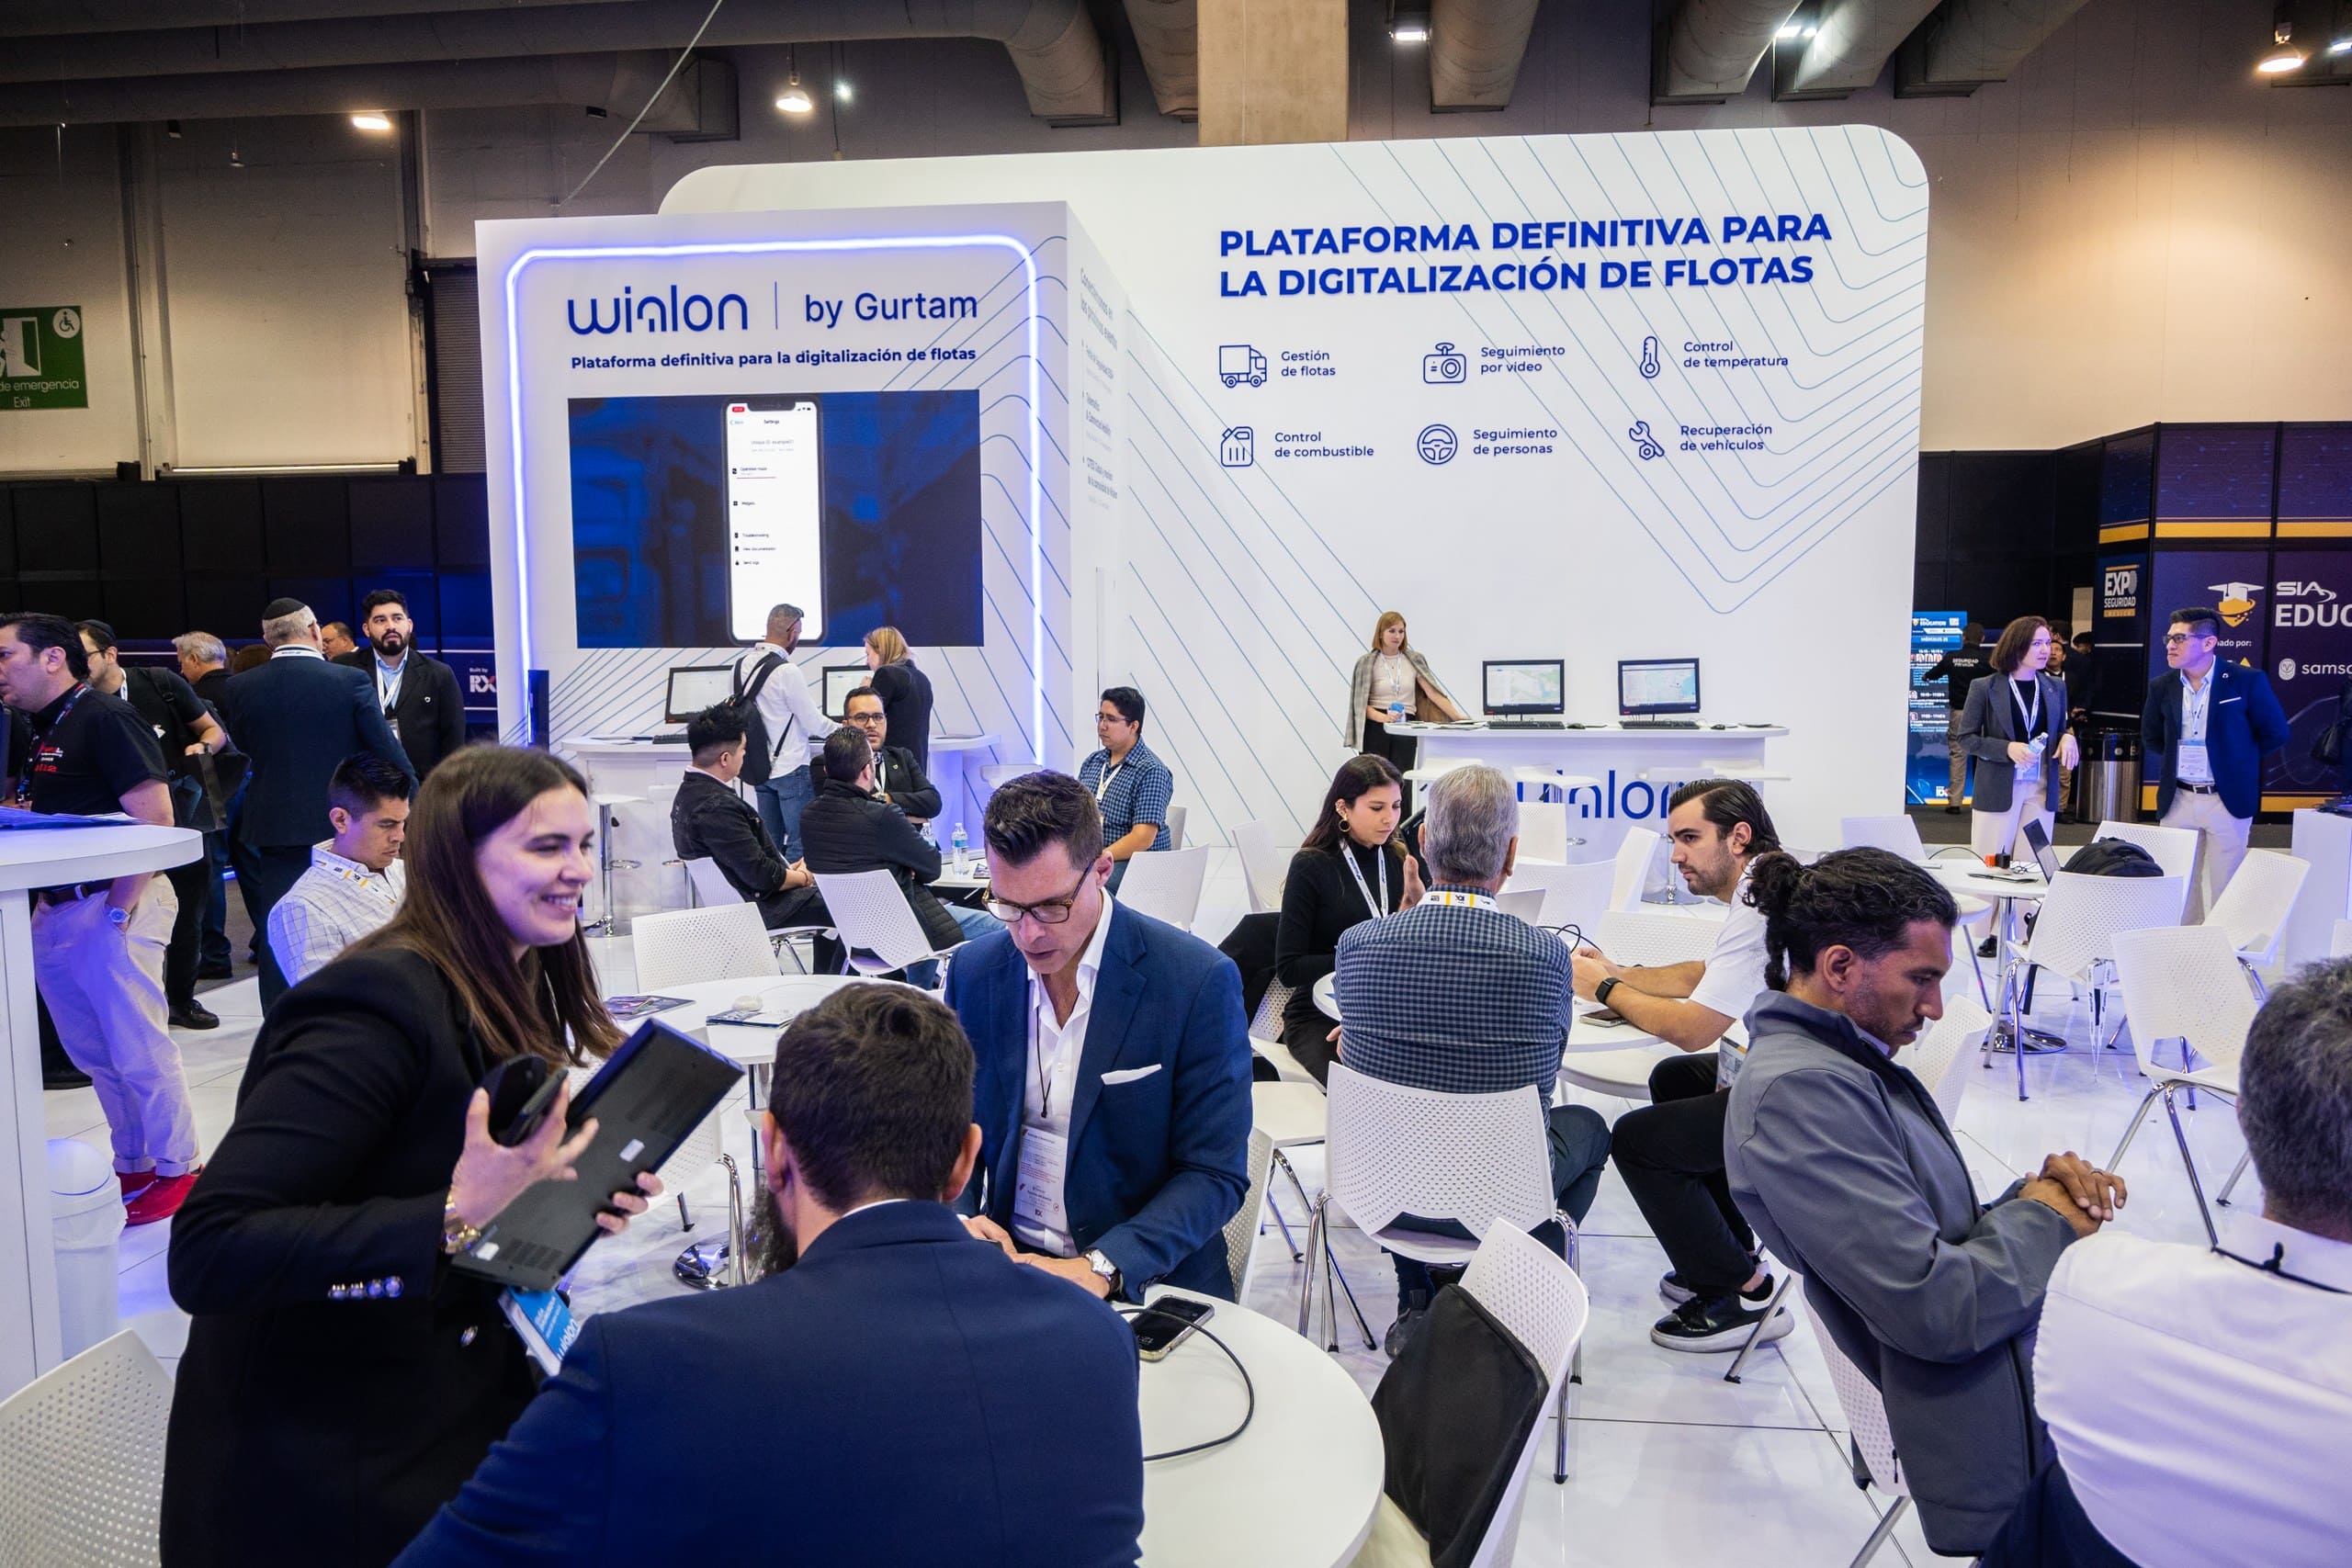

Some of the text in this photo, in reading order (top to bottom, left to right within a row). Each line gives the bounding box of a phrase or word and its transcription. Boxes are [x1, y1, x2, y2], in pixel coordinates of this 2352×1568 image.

[1220, 213, 1833, 257] PLATAFORMA DEFINITIVA PARA
[1220, 255, 1815, 297] LA DIGITALIZACIÓN DE FLOTAS
[567, 284, 748, 335] wialon
[805, 292, 978, 329] by Gurtam
[1480, 345, 1566, 359] Seguimiento
[1683, 341, 1734, 352] Control
[571, 348, 977, 368] Plataforma definitiva para la digitalización de flotas
[1281, 350, 1330, 361] Gestión
[1683, 356, 1789, 369] de temperatura
[1281, 366, 1336, 377] de flotas
[1480, 361, 1543, 375] por video
[14, 378, 80, 393] emergencia
[14, 396, 30, 408] Exit
[1274, 431, 1321, 442] Control
[1473, 427, 1558, 441] Seguimiento
[1679, 423, 1772, 437] Recuperación
[1274, 446, 1374, 457] de combustible
[1473, 445, 1553, 457] de personas
[1679, 439, 1764, 450] de vehículos
[2276, 581, 2327, 596] SIA
[2104, 596, 2137, 608] SEGURIDAD
[469, 674, 497, 693] RX
